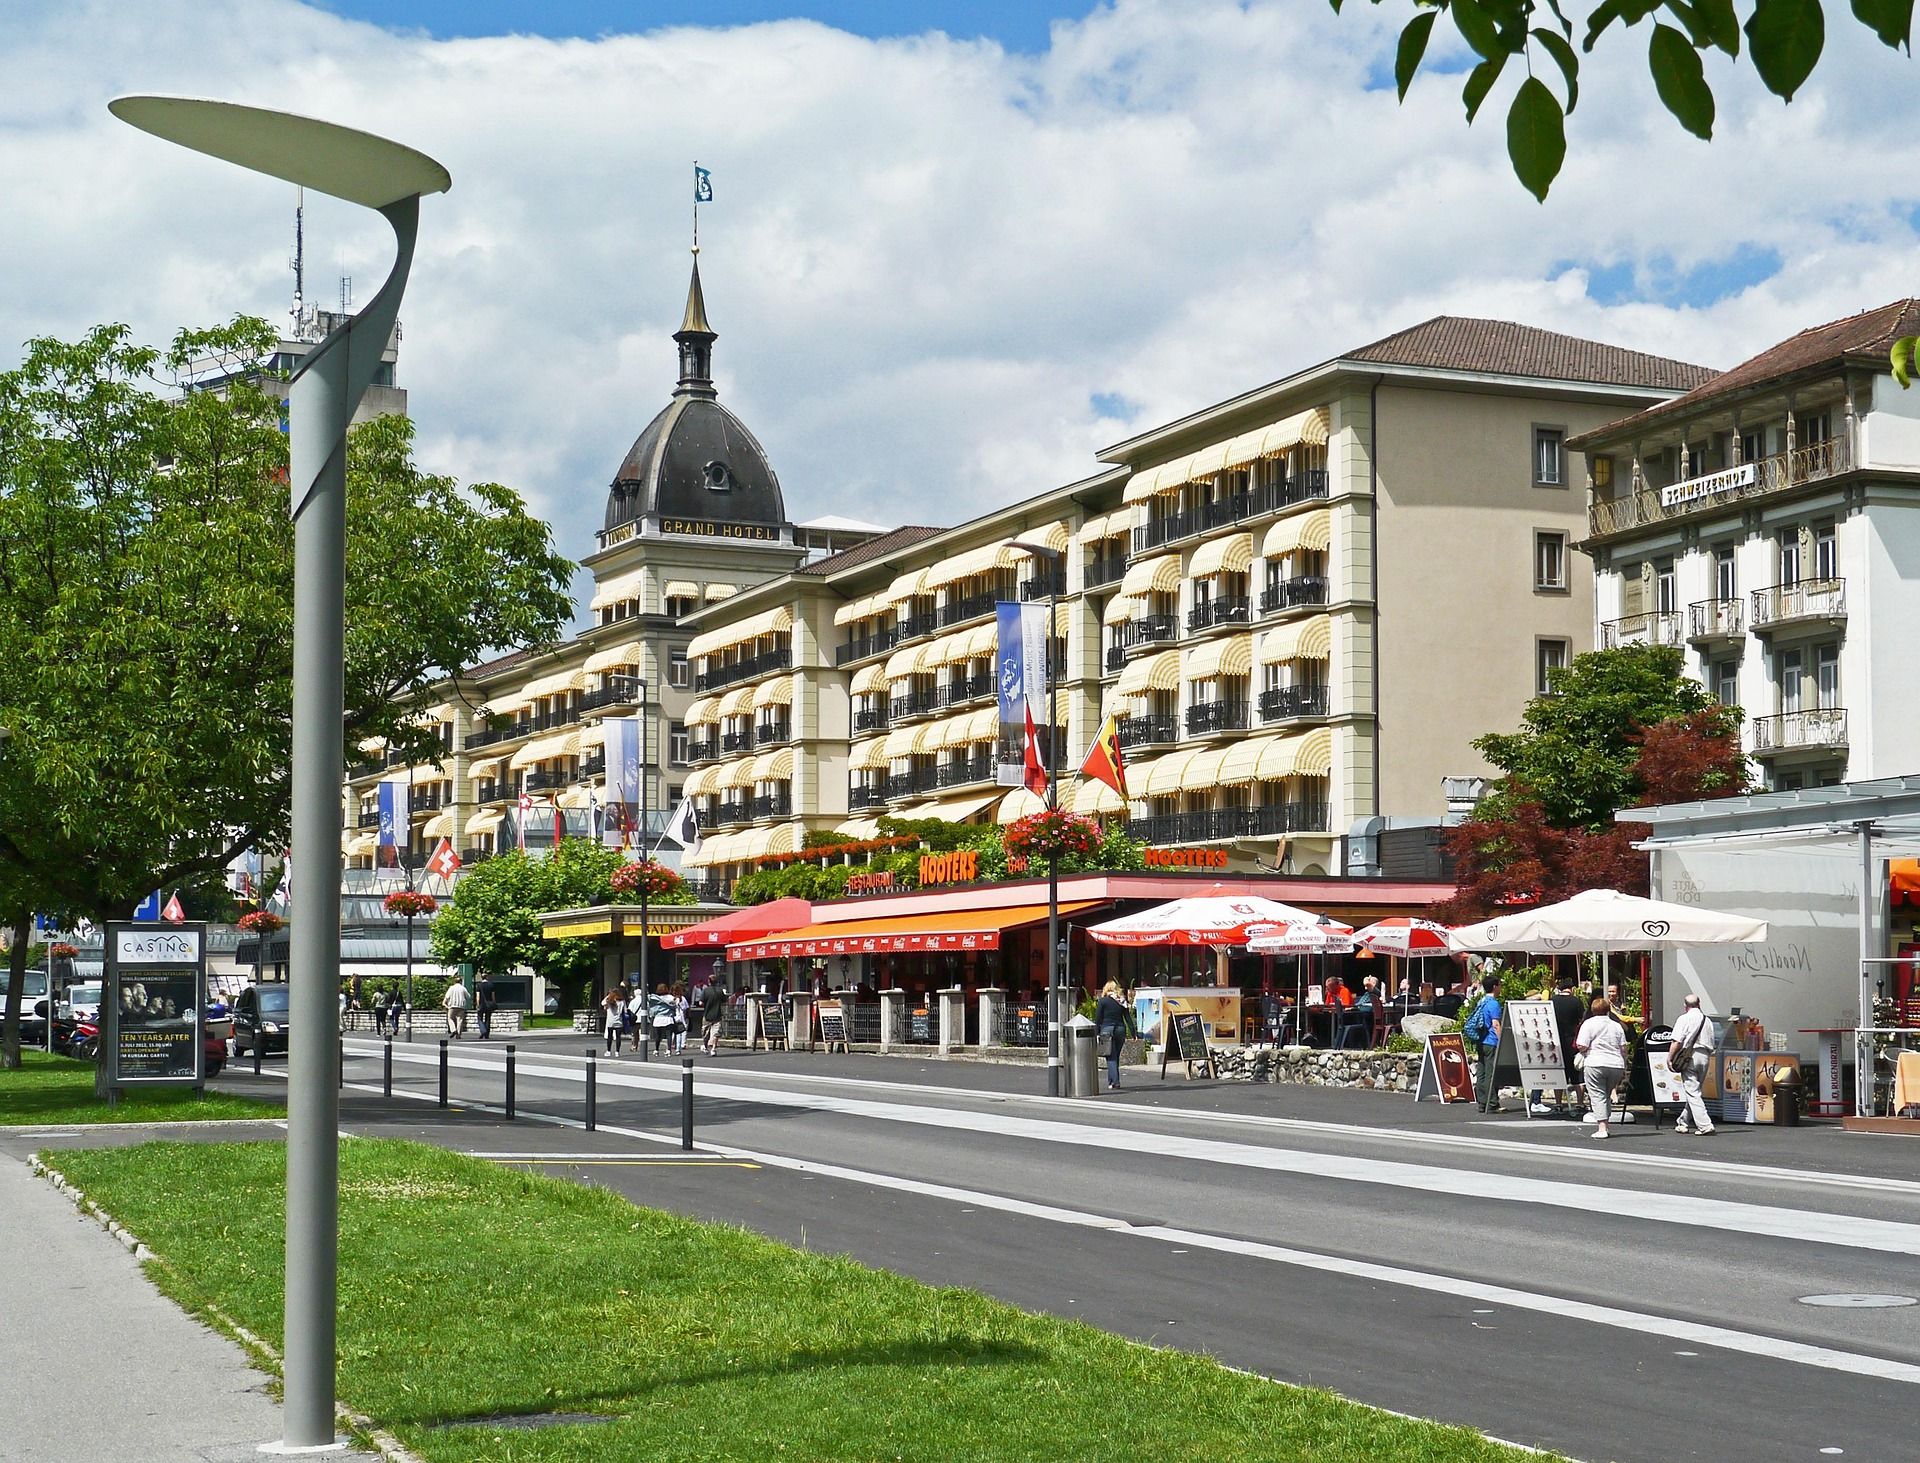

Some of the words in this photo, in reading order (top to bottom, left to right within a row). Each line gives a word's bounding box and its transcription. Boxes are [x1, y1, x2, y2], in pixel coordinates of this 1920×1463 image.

[1667, 470, 1747, 503] SCHWEIZERHOF
[663, 520, 715, 536] GRAND
[722, 525, 774, 540] HOTEL
[1144, 848, 1228, 867] HOOTERS
[919, 851, 979, 884] HOOTERS
[848, 871, 895, 890] RESTAURANT
[123, 942, 189, 953] CASINO
[164, 1033, 190, 1041] AFTER
[1433, 1039, 1461, 1047] MAGNUM
[1726, 1058, 1739, 1073] Art
[1759, 1059, 1779, 1079] Art
